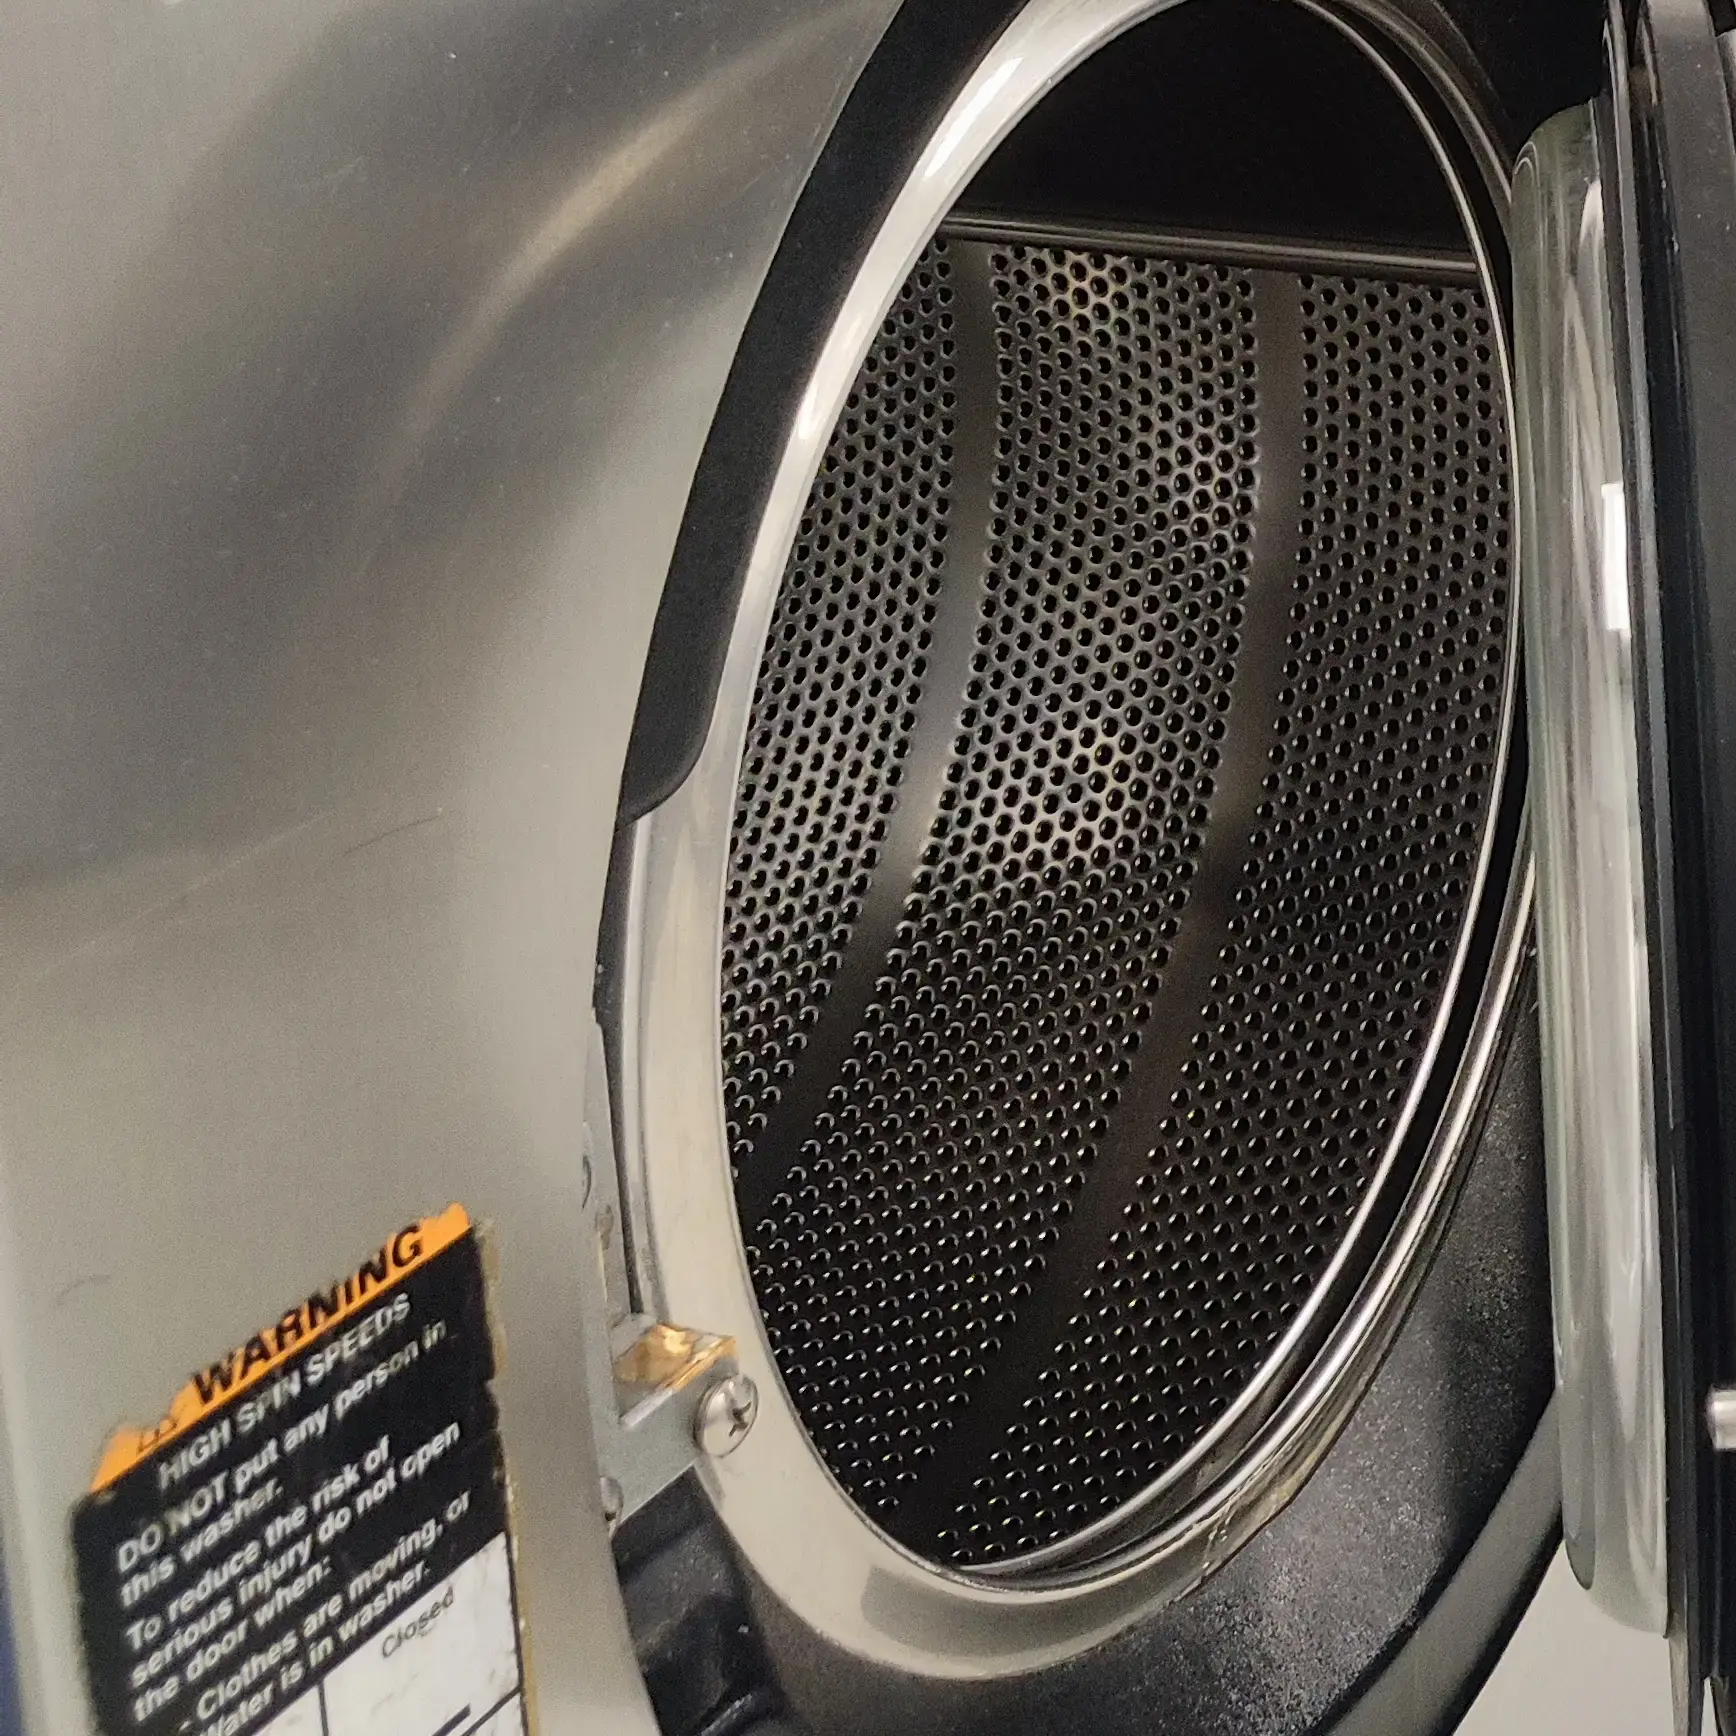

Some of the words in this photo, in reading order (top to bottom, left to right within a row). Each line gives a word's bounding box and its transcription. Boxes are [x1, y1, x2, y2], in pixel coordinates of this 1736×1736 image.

[158, 1418, 232, 1490] HIGH
[236, 1368, 301, 1434] SPIN
[304, 1292, 411, 1387] SPEEDS
[192, 1225, 422, 1404] WARNING
[118, 1524, 164, 1573] DO
[163, 1470, 229, 1536] NOT
[234, 1438, 279, 1494] put
[283, 1403, 329, 1452] any
[333, 1341, 419, 1420] person
[421, 1319, 447, 1352] in
[120, 1555, 177, 1607] this
[181, 1478, 284, 1562] washer.
[126, 1616, 163, 1651] To
[168, 1540, 262, 1623] reduce
[265, 1505, 307, 1549] the
[312, 1463, 360, 1513] risk
[364, 1434, 390, 1474] of
[131, 1597, 234, 1689] serious
[238, 1533, 313, 1605] injury
[318, 1506, 351, 1544] do
[356, 1467, 396, 1514] not
[401, 1421, 461, 1478] open
[197, 1629, 298, 1720] Clothes
[303, 1594, 343, 1639] are
[446, 1489, 471, 1522] or
[280, 1661, 305, 1691] is
[308, 1635, 334, 1668] in
[338, 1561, 431, 1642] washer.
[382, 1585, 455, 1660] Closed
[134, 1675, 180, 1722] the
[187, 1618, 248, 1682] door
[254, 1556, 332, 1627] when:
